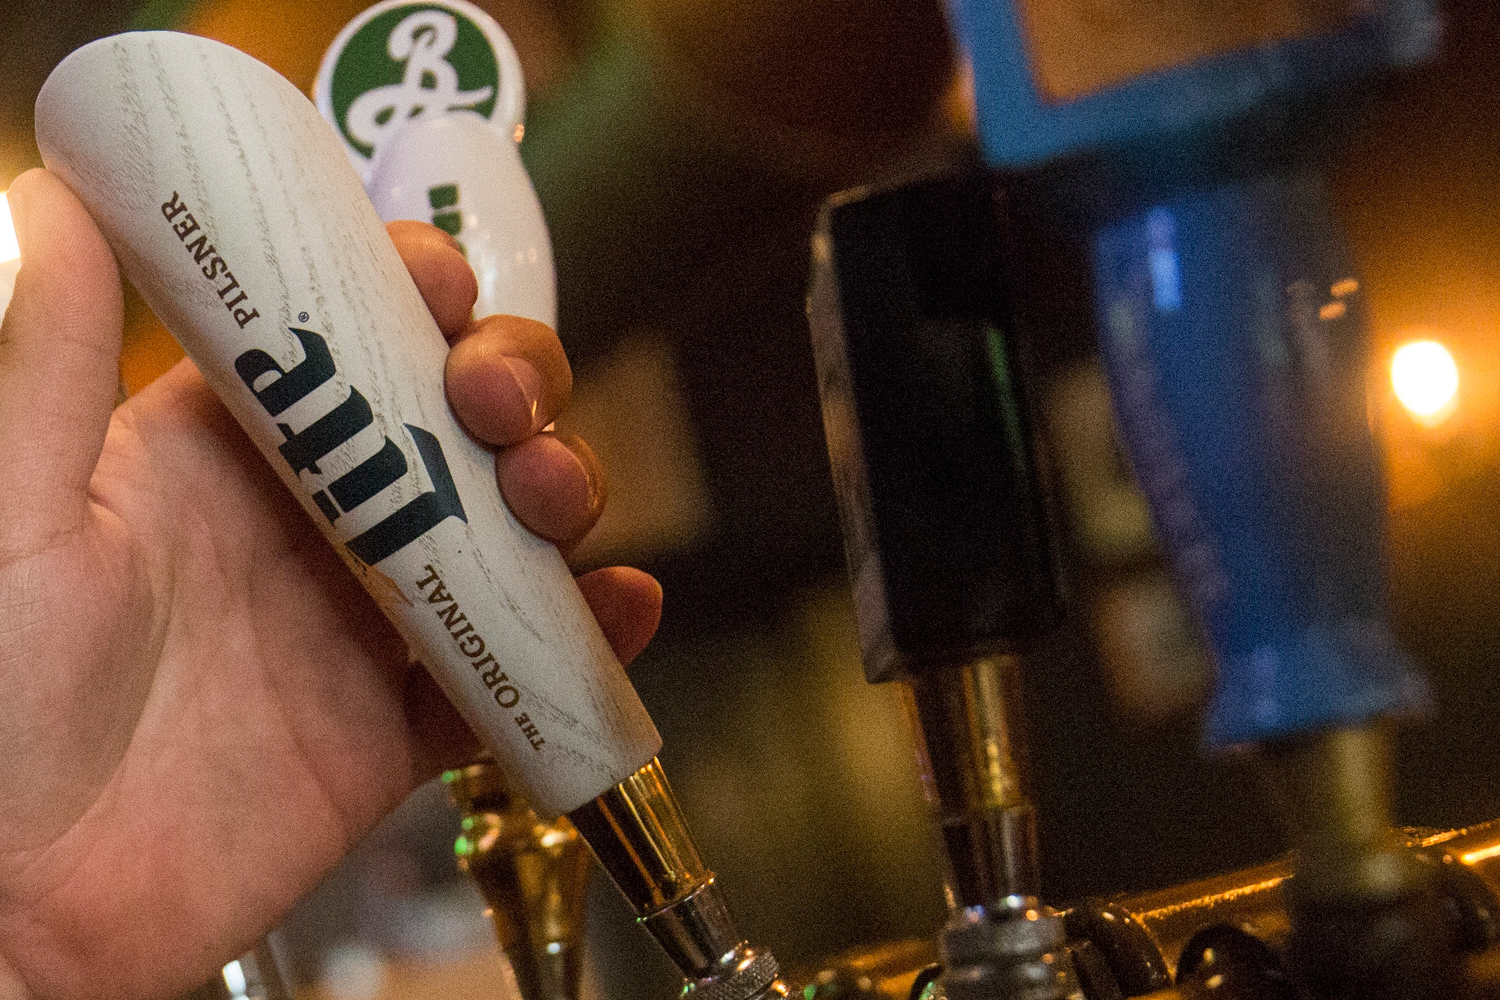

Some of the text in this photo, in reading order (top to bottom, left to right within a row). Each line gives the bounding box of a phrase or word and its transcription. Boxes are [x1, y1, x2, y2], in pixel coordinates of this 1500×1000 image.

[161, 190, 260, 330] PILSNER
[234, 326, 468, 566] Lite
[415, 564, 546, 751] THE ORIGINAL
